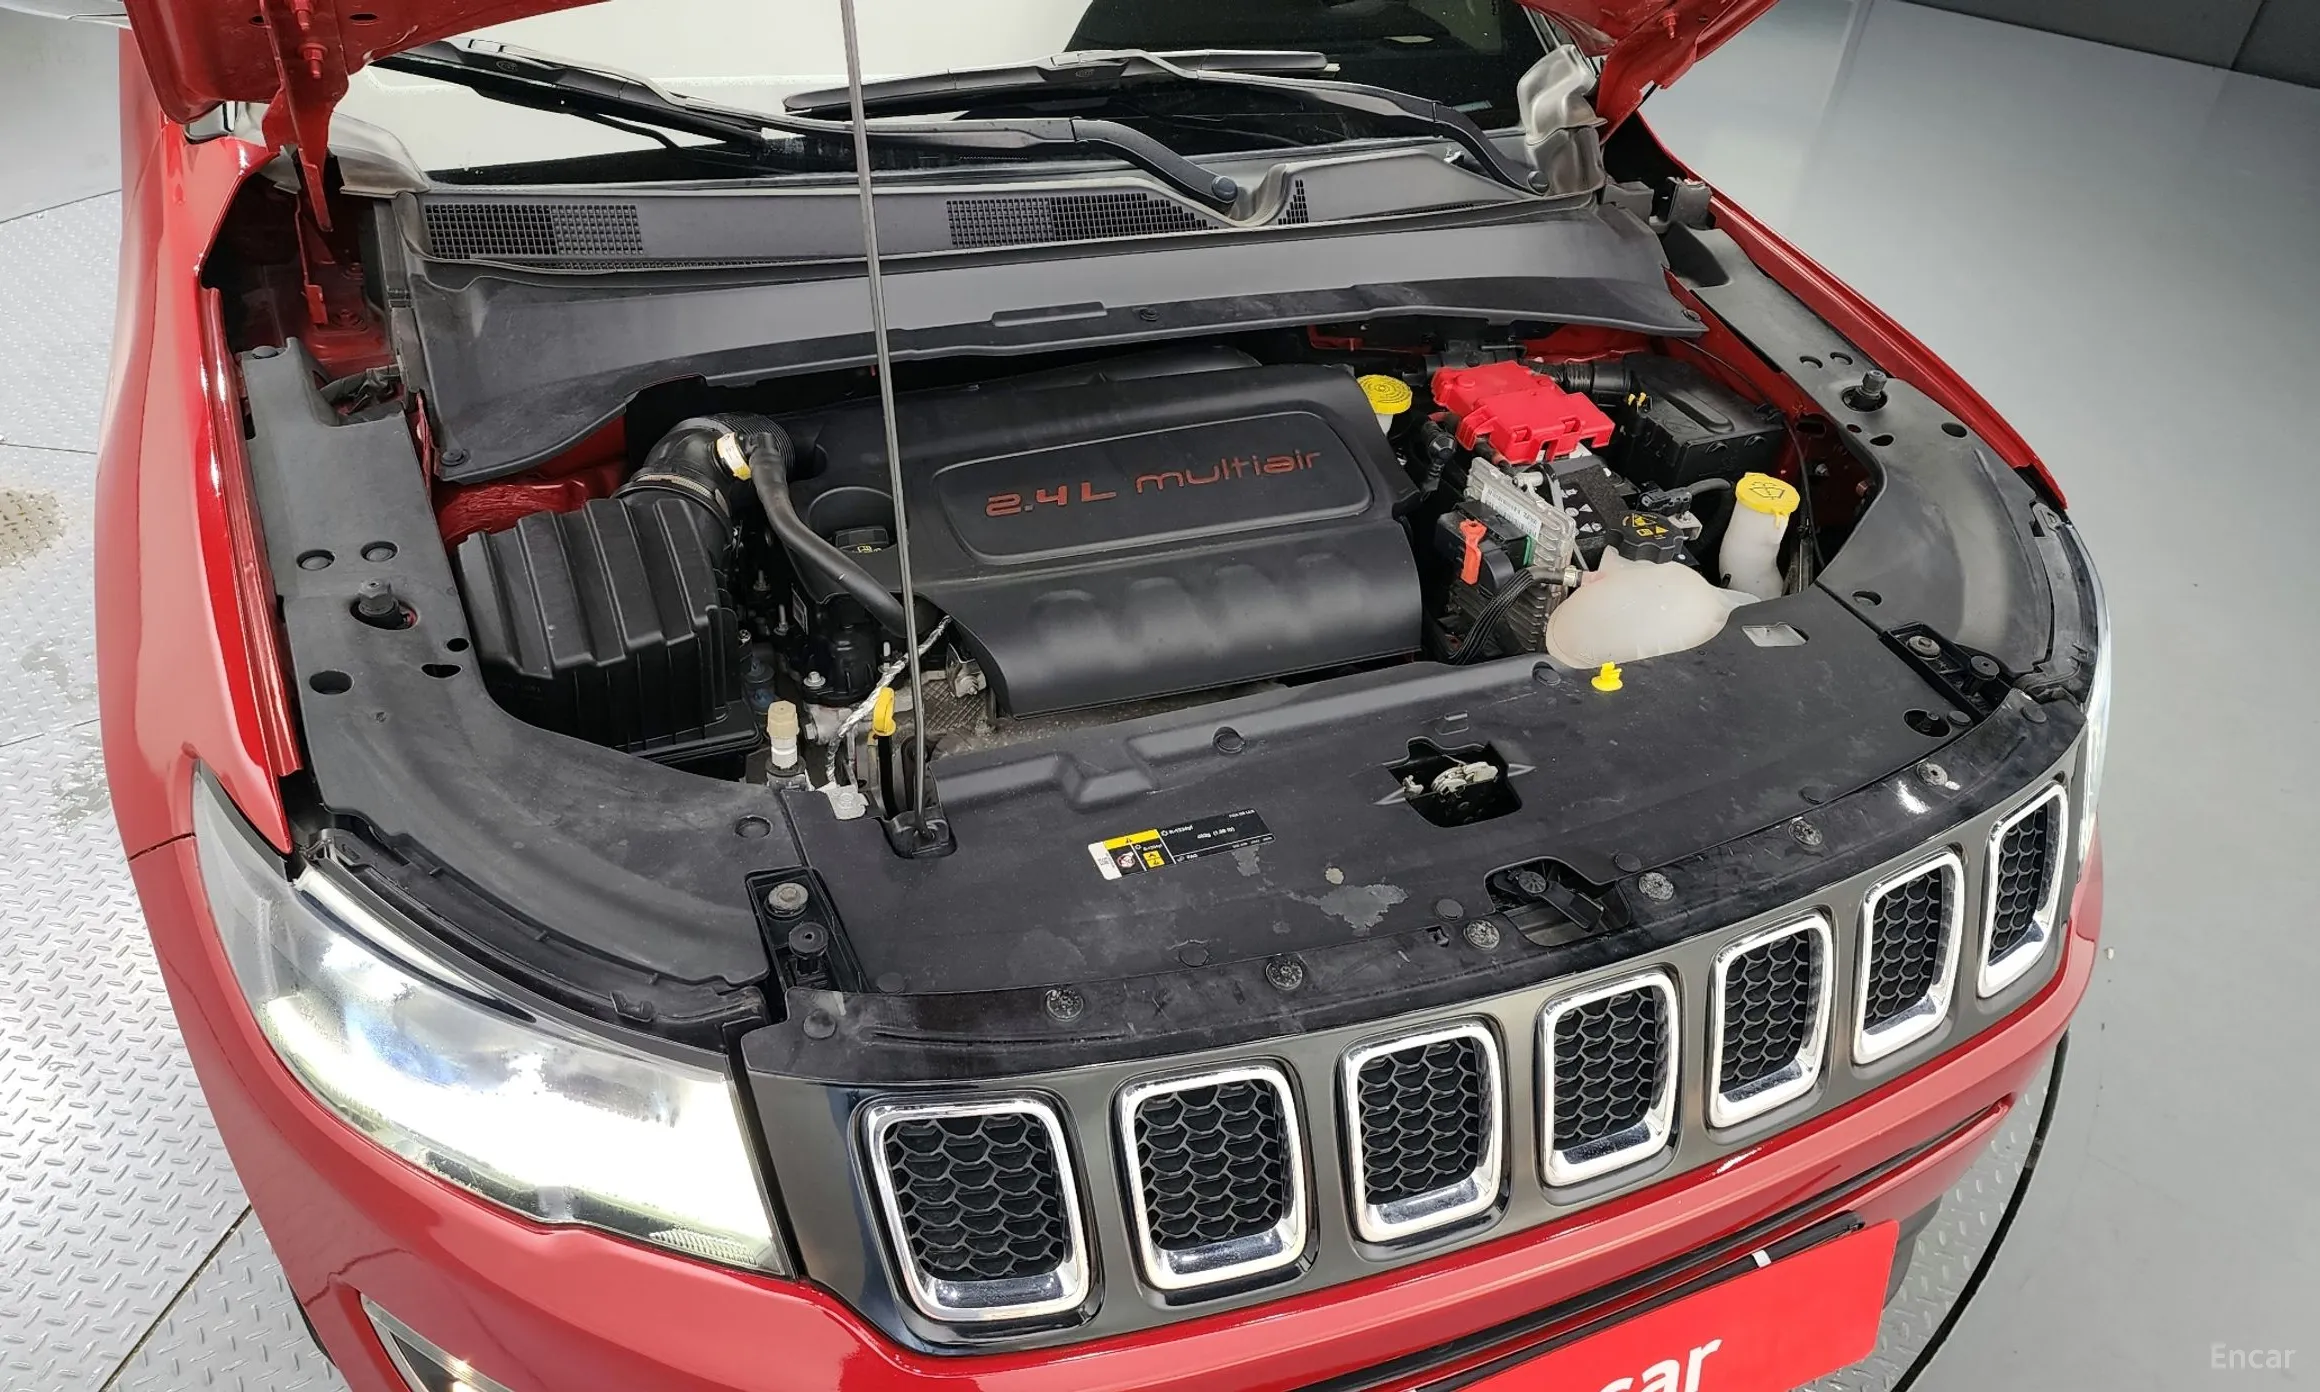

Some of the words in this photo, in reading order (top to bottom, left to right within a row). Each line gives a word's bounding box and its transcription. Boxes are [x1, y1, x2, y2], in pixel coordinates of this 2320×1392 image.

[985, 484, 1068, 518] 2.4
[1080, 480, 1117, 503] L
[1135, 449, 1321, 495] multiair
[1599, 1338, 1723, 1392] ar
